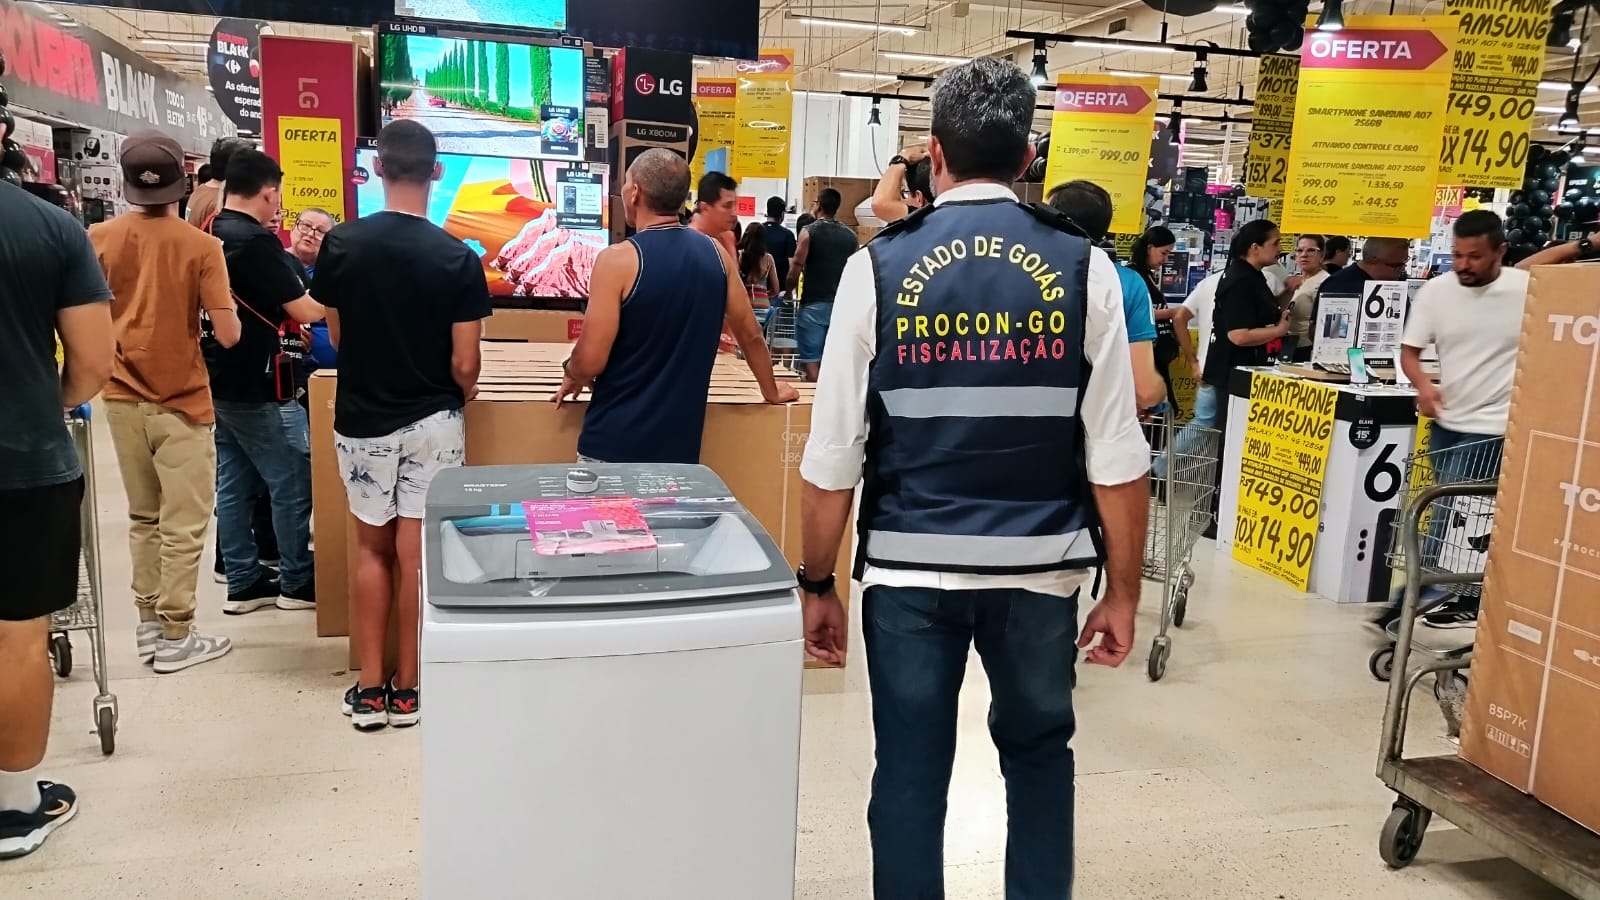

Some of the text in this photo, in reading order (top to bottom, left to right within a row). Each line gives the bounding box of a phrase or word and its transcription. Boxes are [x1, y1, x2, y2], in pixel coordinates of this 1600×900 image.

[1449, 10, 1547, 40] AMSUNG
[1310, 39, 1412, 59] OFERTA
[225, 81, 260, 95] As ofertas
[659, 78, 683, 95] LG
[699, 86, 732, 94] OFERTA
[1062, 91, 1128, 106] OFERTA
[240, 108, 249, 117] do
[1307, 107, 1432, 119] SMARTPHONE SAMSUNG A07
[285, 129, 337, 142] OFERTA
[1312, 141, 1419, 152] ATIVANDO CONTROLE CLARO
[1460, 127, 1530, 173] 14,90
[1100, 150, 1140, 163] 999,00
[292, 187, 337, 198] 1.699,00
[1303, 195, 1336, 206] 66,59
[1365, 197, 1399, 208] 44,55
[896, 235, 1065, 307] ESTADO DE GOIÁS
[1365, 284, 1385, 318] 6
[896, 310, 1065, 340] PROCON-GO
[897, 335, 1065, 364] FISCALIZAÇÃO
[1251, 374, 1336, 415] SMARTPHONE
[1248, 402, 1331, 440] SAMSUNG
[1364, 443, 1401, 502] 6
[1234, 515, 1314, 568] 10X 14,90
[1488, 703, 1529, 732] 85P7K
